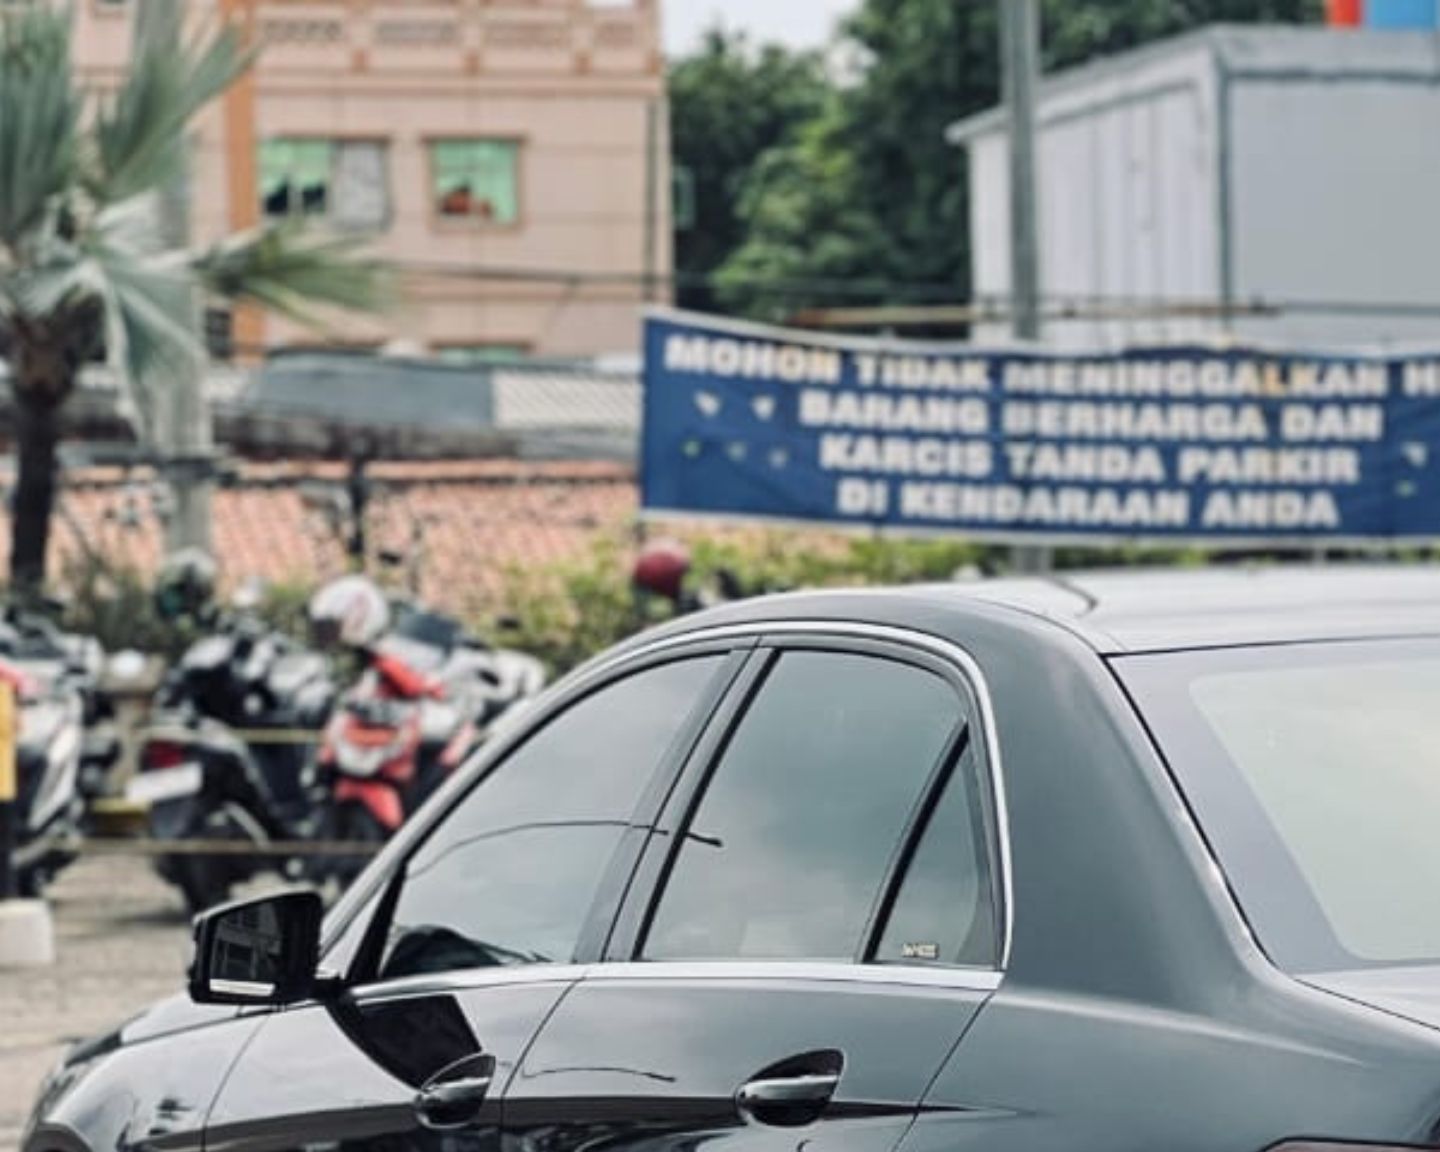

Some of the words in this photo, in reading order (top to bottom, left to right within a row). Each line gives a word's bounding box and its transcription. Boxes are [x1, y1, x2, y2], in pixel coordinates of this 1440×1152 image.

[664, 334, 840, 381] MOHON
[857, 351, 991, 389] TIDAK
[1007, 359, 1386, 396] MENINGGALKAN
[801, 391, 988, 434] BARANG
[1004, 401, 1267, 440] BERHARGA
[1281, 404, 1382, 442] DAN
[821, 438, 992, 475] KARCIS
[1008, 443, 1166, 481] TANDA
[1179, 447, 1360, 484] PARKIR
[838, 481, 889, 517] DI
[902, 485, 1187, 525] KENDARAAN
[1203, 490, 1338, 528] ANDA
